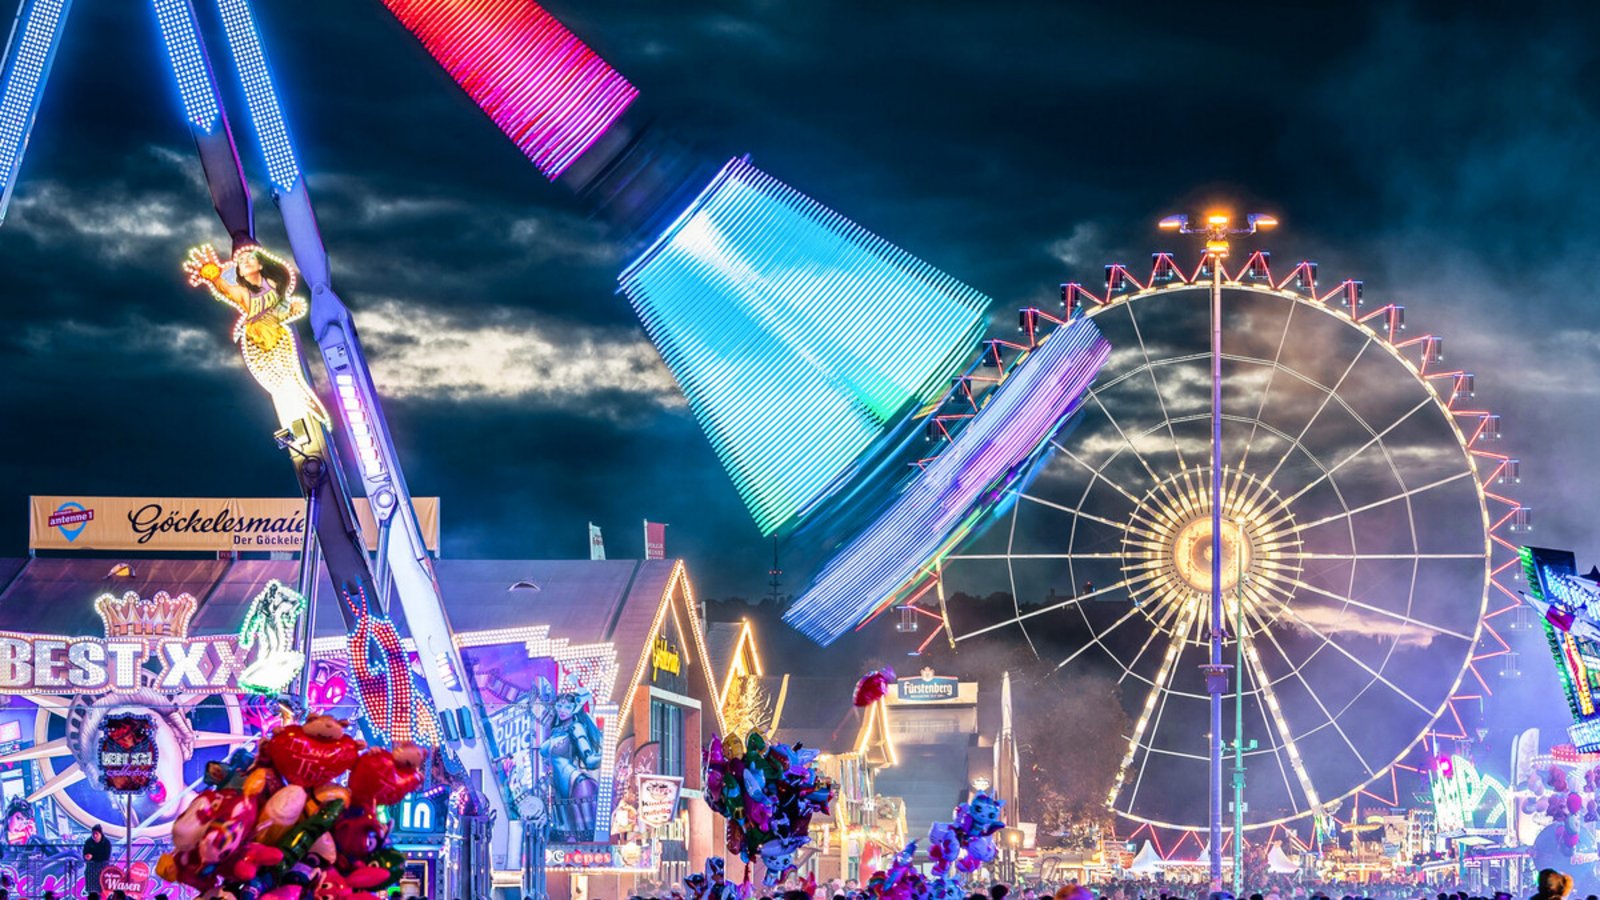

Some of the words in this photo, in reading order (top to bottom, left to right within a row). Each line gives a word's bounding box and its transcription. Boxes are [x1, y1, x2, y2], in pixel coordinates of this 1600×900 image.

[50, 513, 88, 525] antenne
[127, 503, 304, 544] Göckelesmaie
[234, 535, 252, 544] Der
[256, 535, 303, 544] Göckeles
[113, 624, 172, 635] THE
[0, 638, 144, 687] BEST
[162, 640, 249, 687] XX
[904, 681, 953, 696] Fürstenberg
[496, 714, 531, 741] OUTH
[402, 792, 430, 828] in
[553, 849, 612, 866] Crêpes
[105, 877, 141, 891] Wasen
